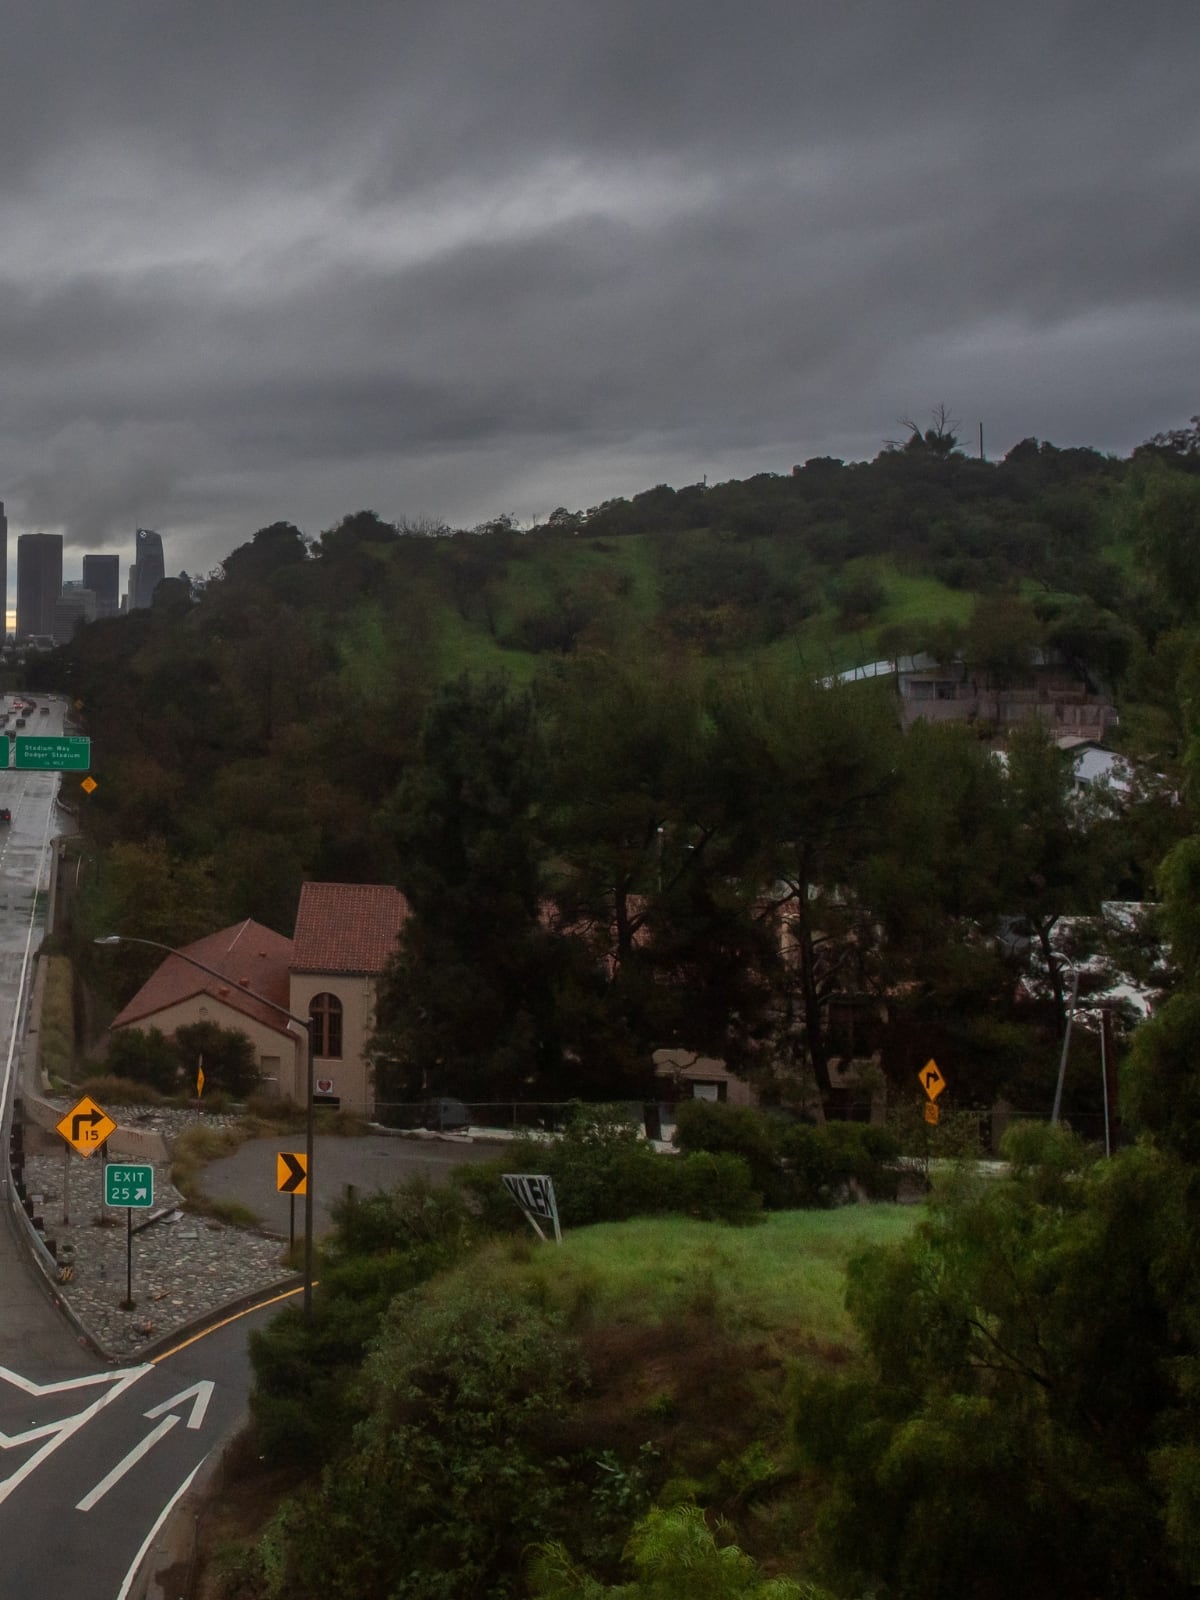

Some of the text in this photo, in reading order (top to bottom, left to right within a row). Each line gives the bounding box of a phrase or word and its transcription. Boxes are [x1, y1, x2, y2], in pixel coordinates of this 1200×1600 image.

[85, 1130, 99, 1140] 15
[114, 1171, 145, 1182] EXIT
[111, 1187, 130, 1200] 25
